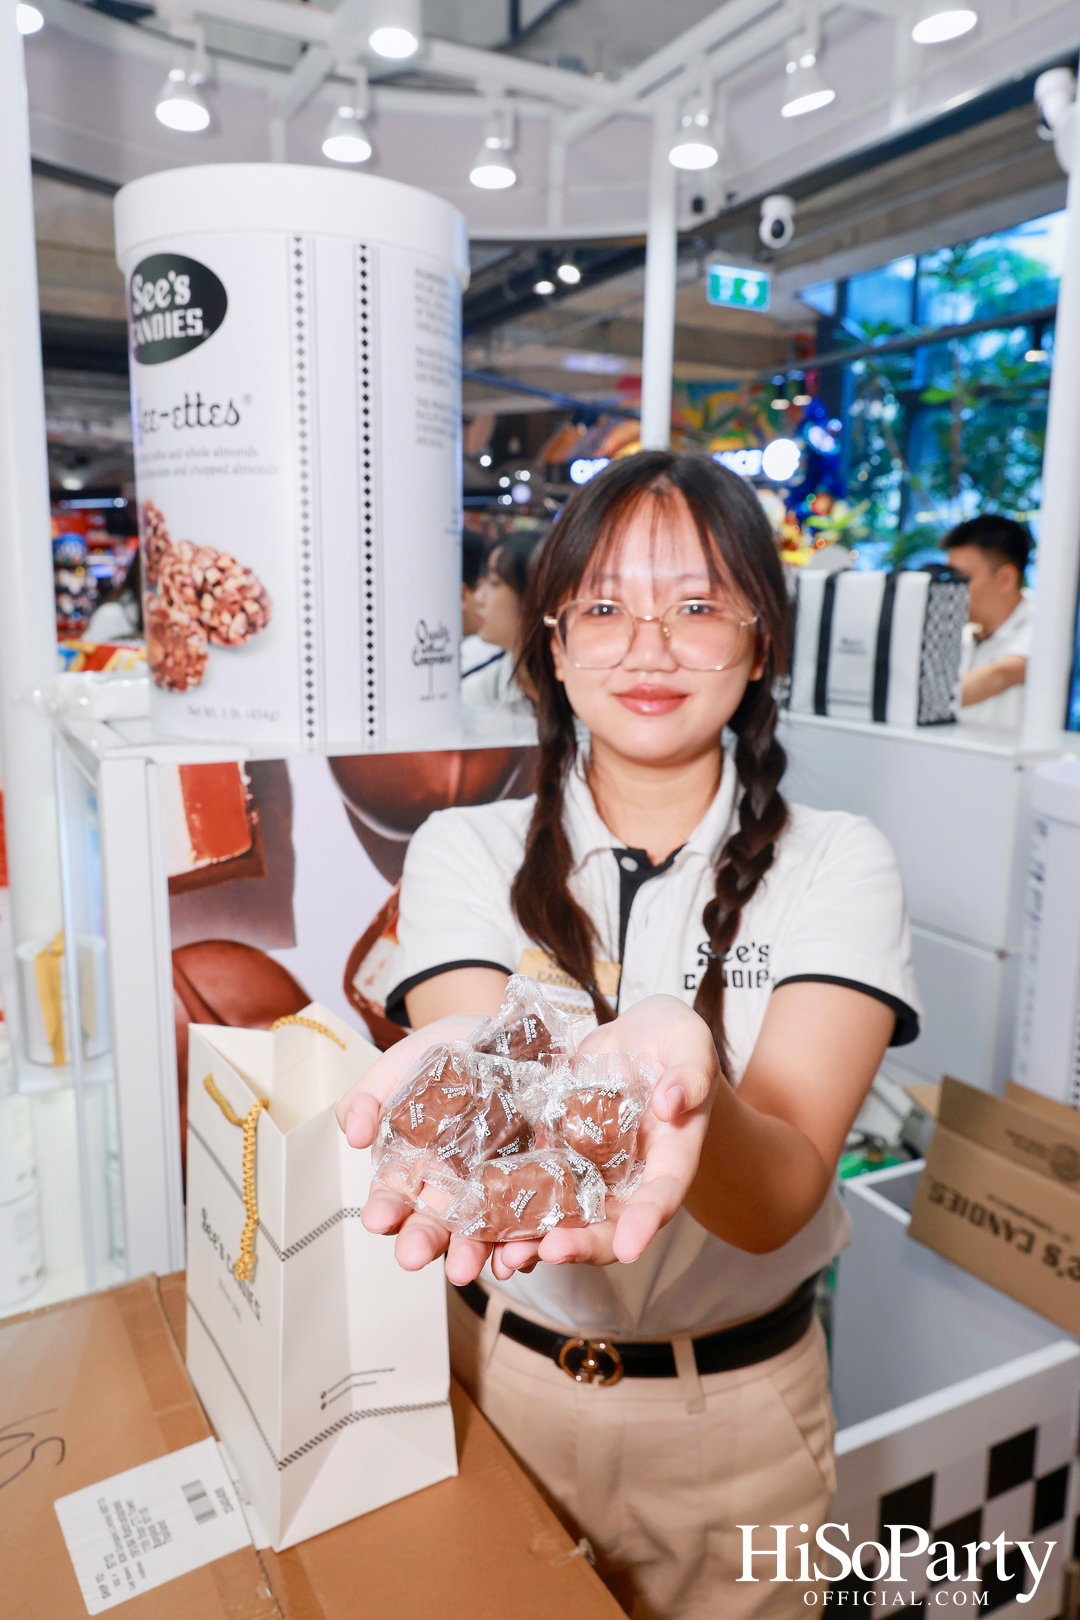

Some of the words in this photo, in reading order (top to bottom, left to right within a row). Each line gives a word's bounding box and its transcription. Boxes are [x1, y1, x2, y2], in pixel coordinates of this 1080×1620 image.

[132, 270, 191, 316] See's
[697, 941, 769, 967] Se's
[408, 1100, 419, 1130] CANDIES
[585, 1116, 604, 1136] See's
[510, 1188, 527, 1211] See's
[514, 1189, 537, 1219] CANDIES
[463, 1218, 486, 1237] See's
